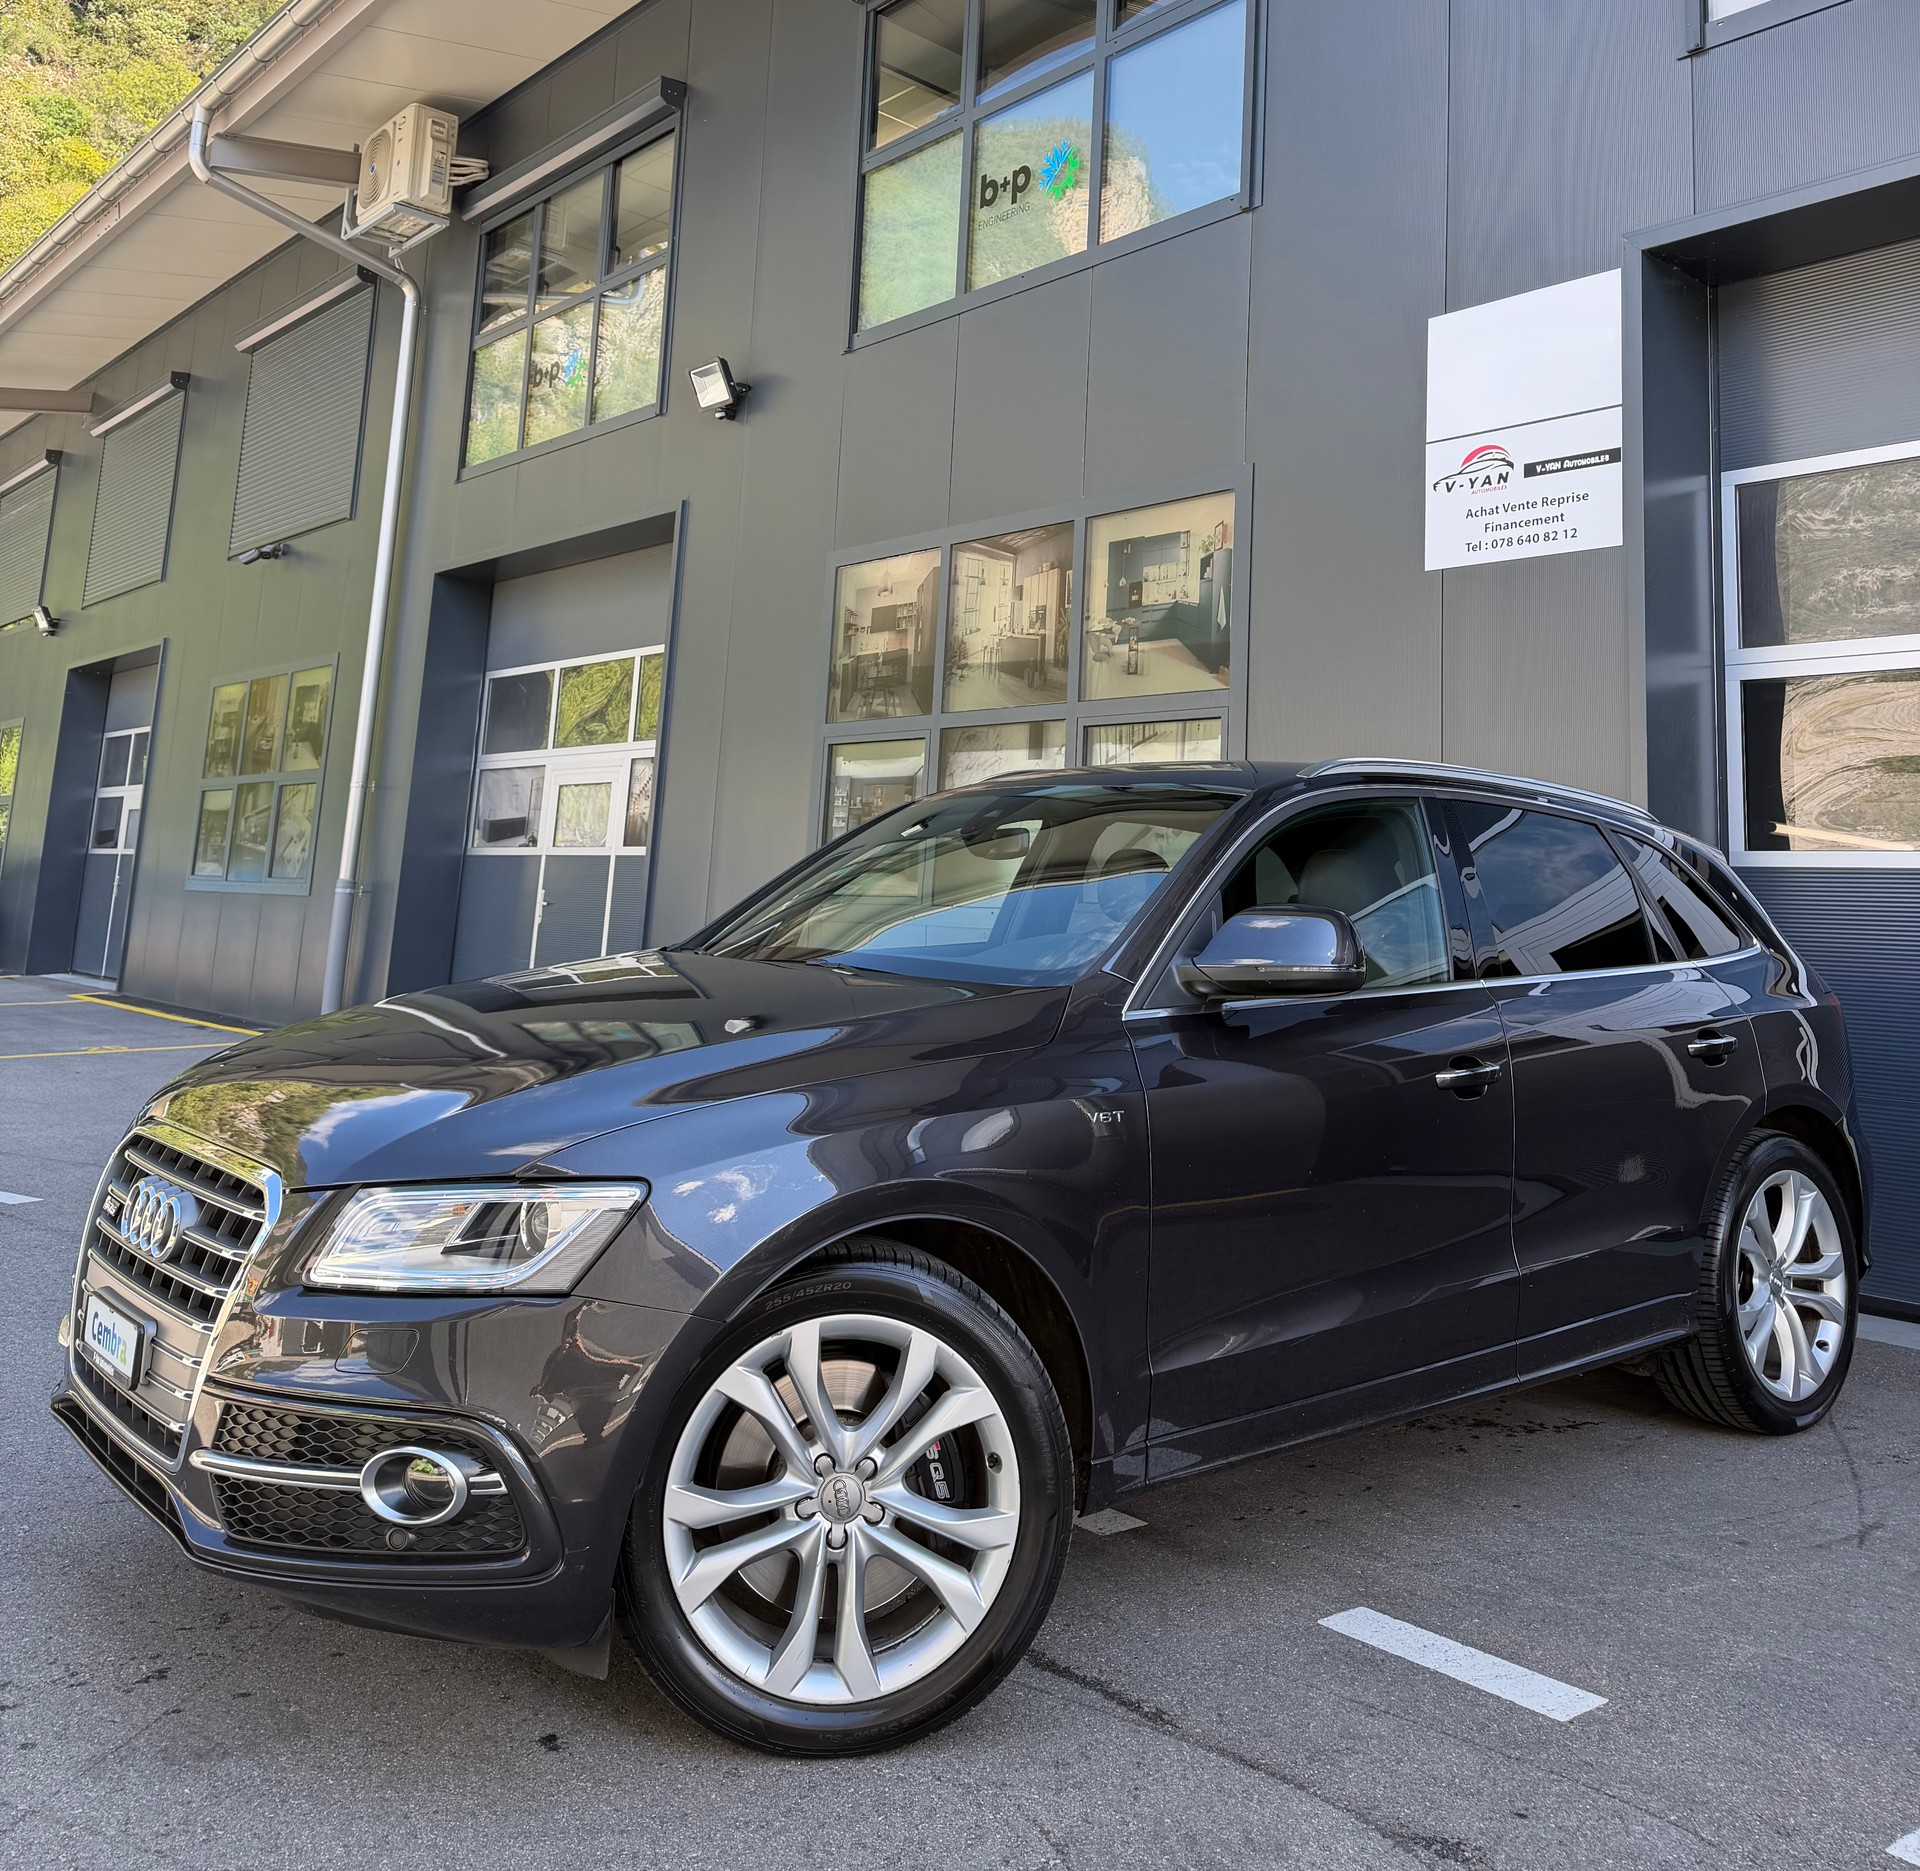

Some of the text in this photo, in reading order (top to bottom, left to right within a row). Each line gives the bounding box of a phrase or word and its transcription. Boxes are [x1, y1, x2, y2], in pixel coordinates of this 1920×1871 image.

[980, 165, 1031, 209] b+p
[978, 202, 1030, 231] ENGINEERING
[1535, 460, 1561, 473] V-YAN
[1445, 471, 1509, 493] V-YAN
[1471, 485, 1508, 495] AUTOMOBILES
[1466, 492, 1589, 519] Achat Vente Reprise
[1485, 513, 1565, 533] Financement
[1491, 537, 1513, 549] 078
[1517, 533, 1540, 545] 640
[1543, 530, 1558, 542] 82
[1563, 528, 1578, 539] 12
[1087, 1110, 1124, 1123] V6T
[765, 1280, 852, 1310] 255/45ZR20
[92, 1311, 127, 1365] Cembra
